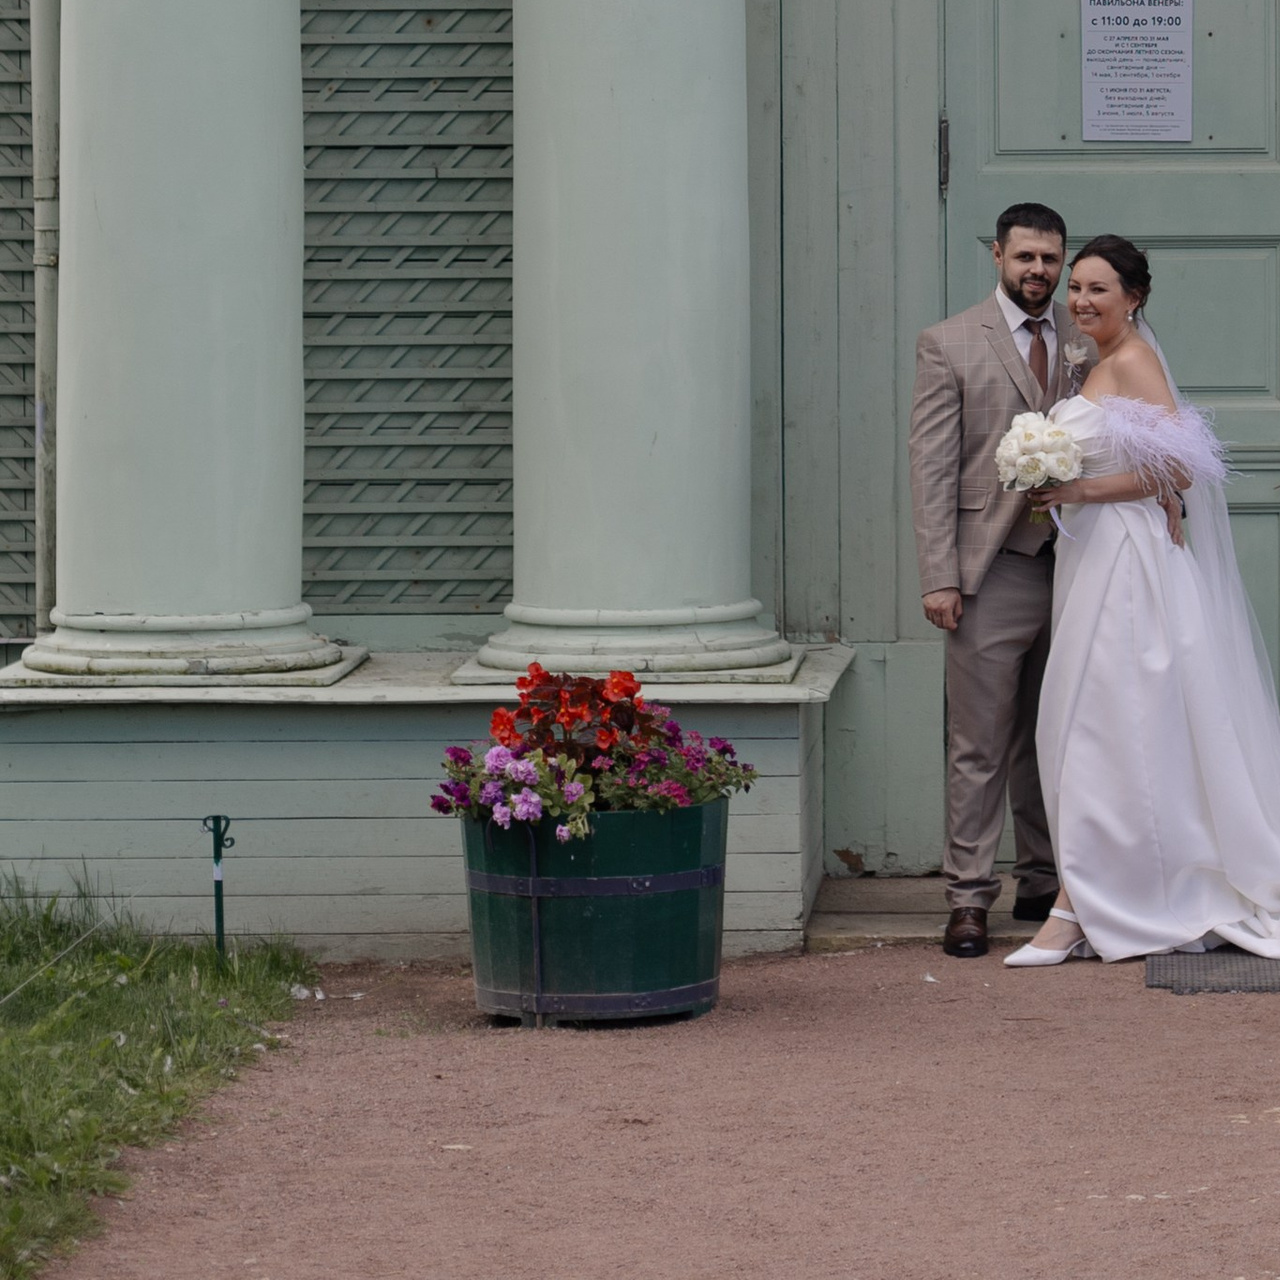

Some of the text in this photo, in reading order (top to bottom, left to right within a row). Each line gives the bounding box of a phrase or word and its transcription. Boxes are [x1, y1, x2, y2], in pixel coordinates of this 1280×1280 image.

[1091, 16, 1181, 27] с 11:00 до 19:00
